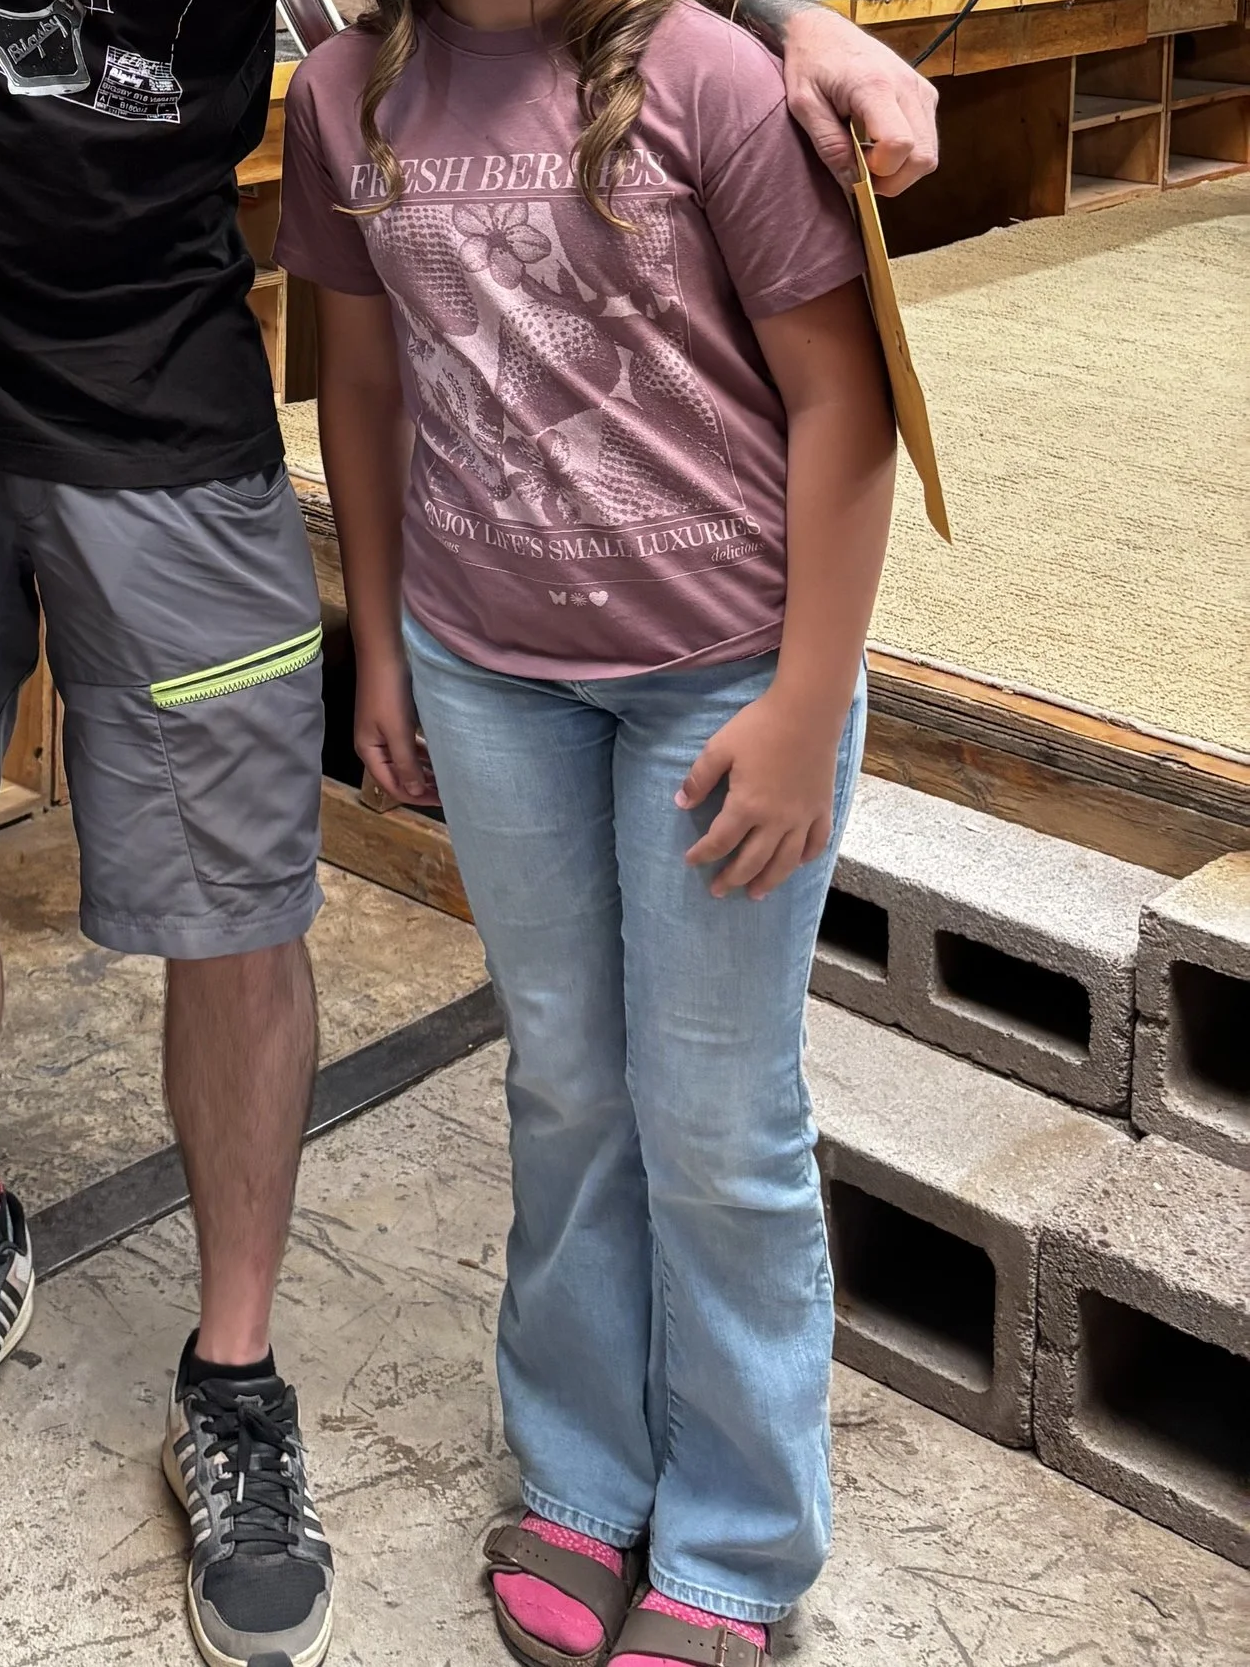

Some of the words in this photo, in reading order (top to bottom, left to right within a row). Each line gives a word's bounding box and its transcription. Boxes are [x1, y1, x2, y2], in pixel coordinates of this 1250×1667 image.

[7, 15, 68, 65] Bigsby
[424, 499, 480, 541] ENJOY
[484, 523, 544, 559] LIFE'S
[548, 537, 634, 562] SMALL
[637, 513, 762, 557] LUXURIES
